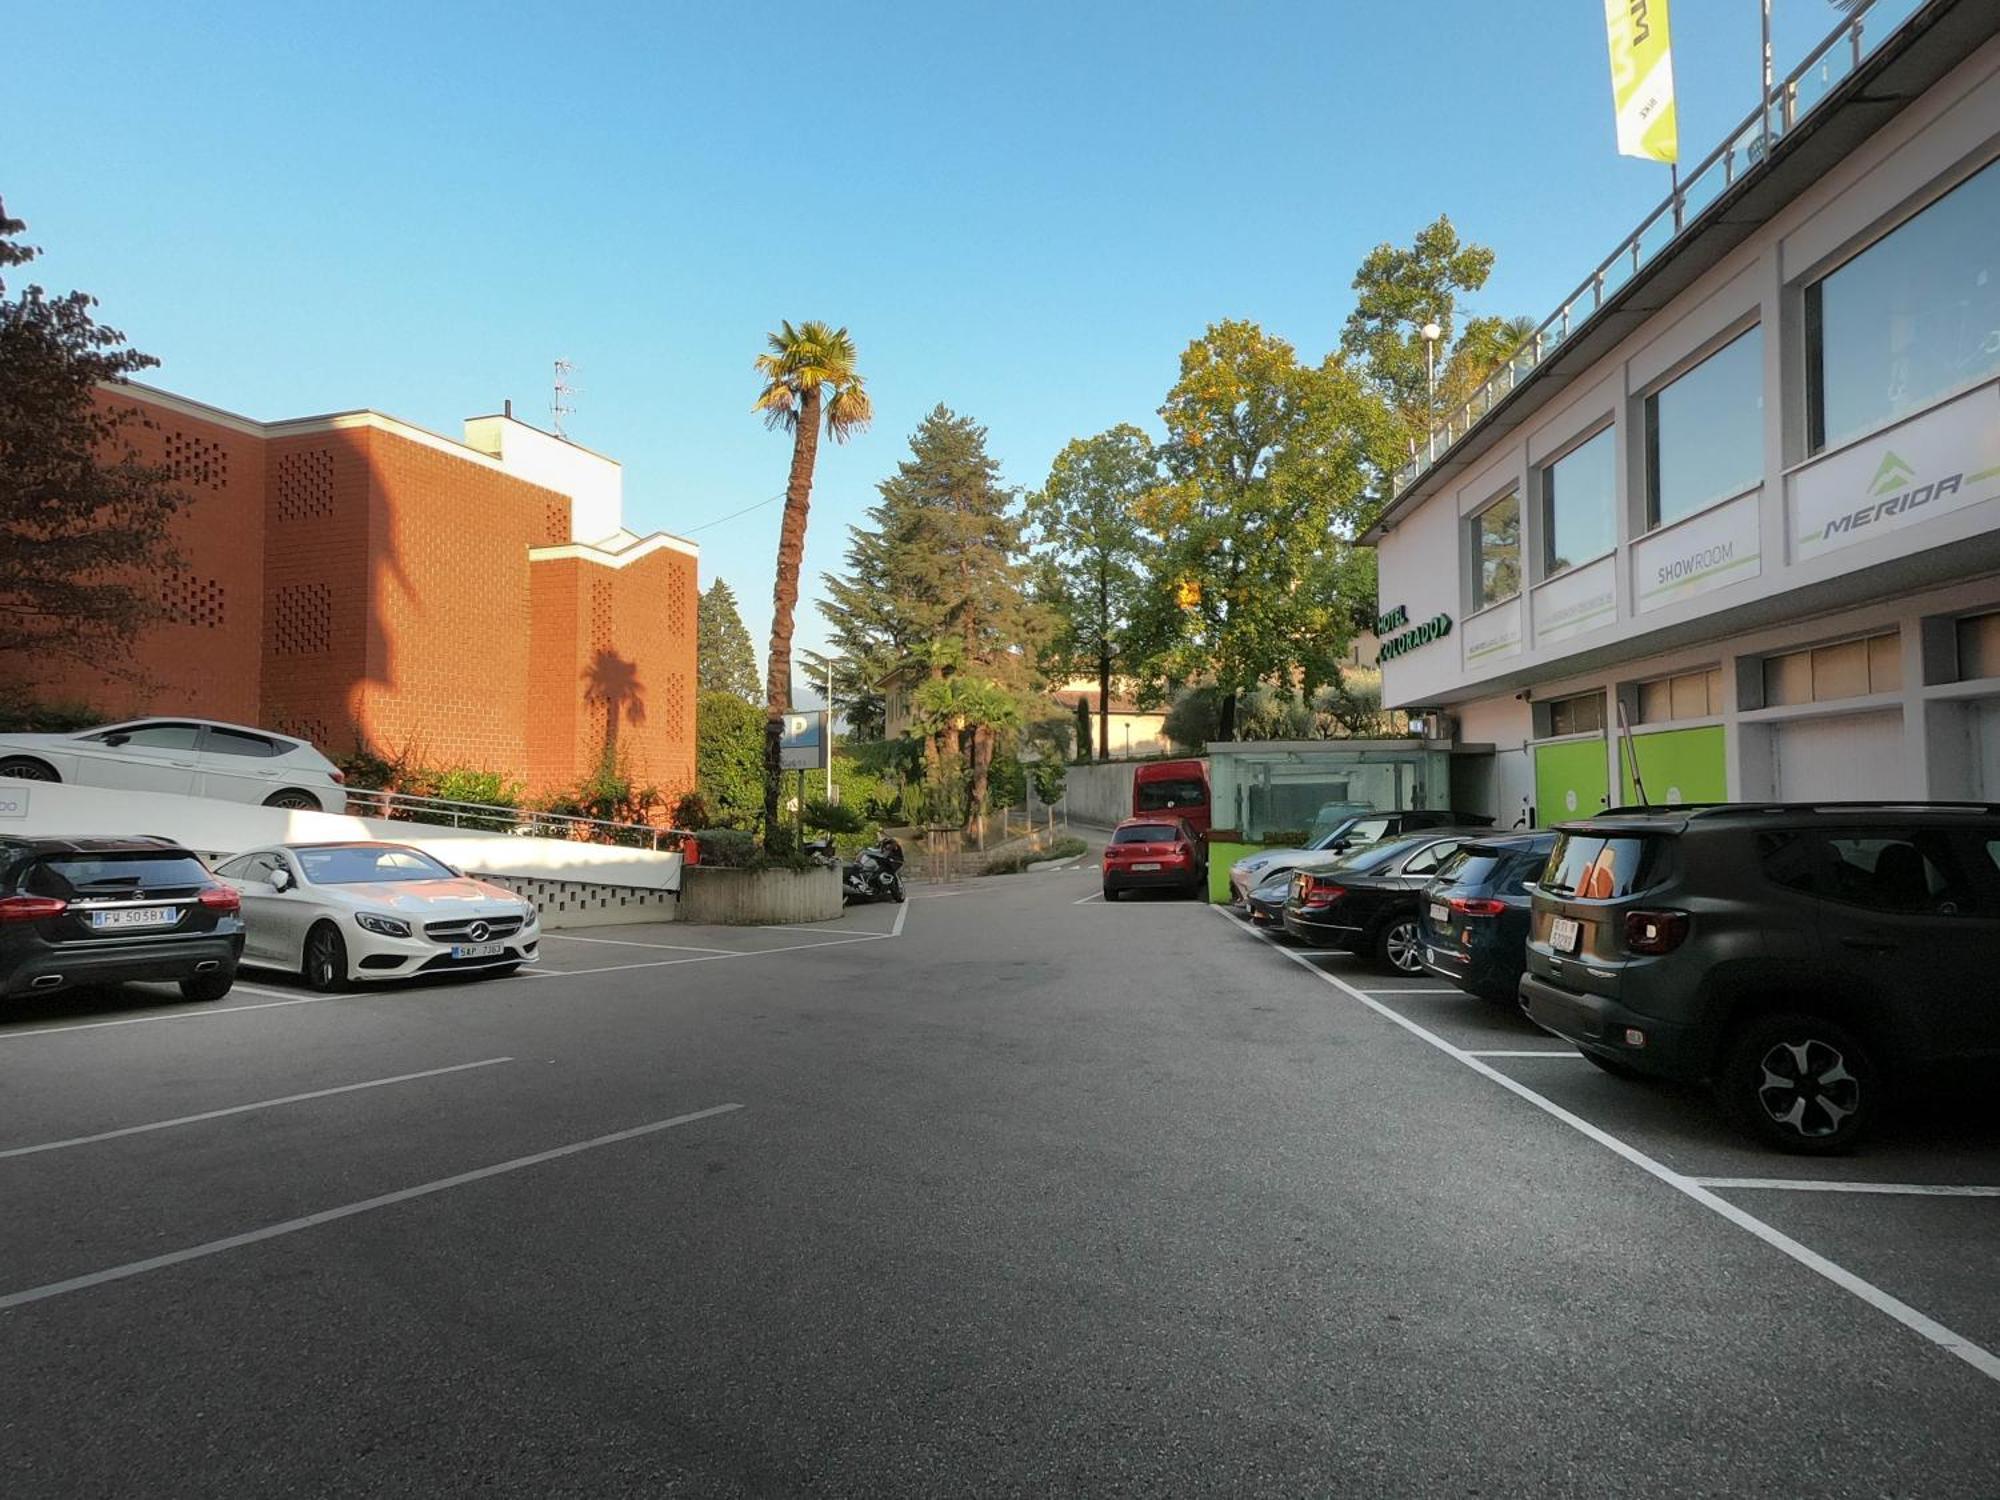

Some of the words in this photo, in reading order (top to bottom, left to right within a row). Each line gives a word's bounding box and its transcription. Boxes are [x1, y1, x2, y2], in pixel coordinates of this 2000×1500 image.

[1823, 472, 1963, 541] MERIDA
[1657, 541, 1734, 584] SHOWROOM
[1377, 605, 1409, 635] HOTEL
[791, 716, 808, 744] P
